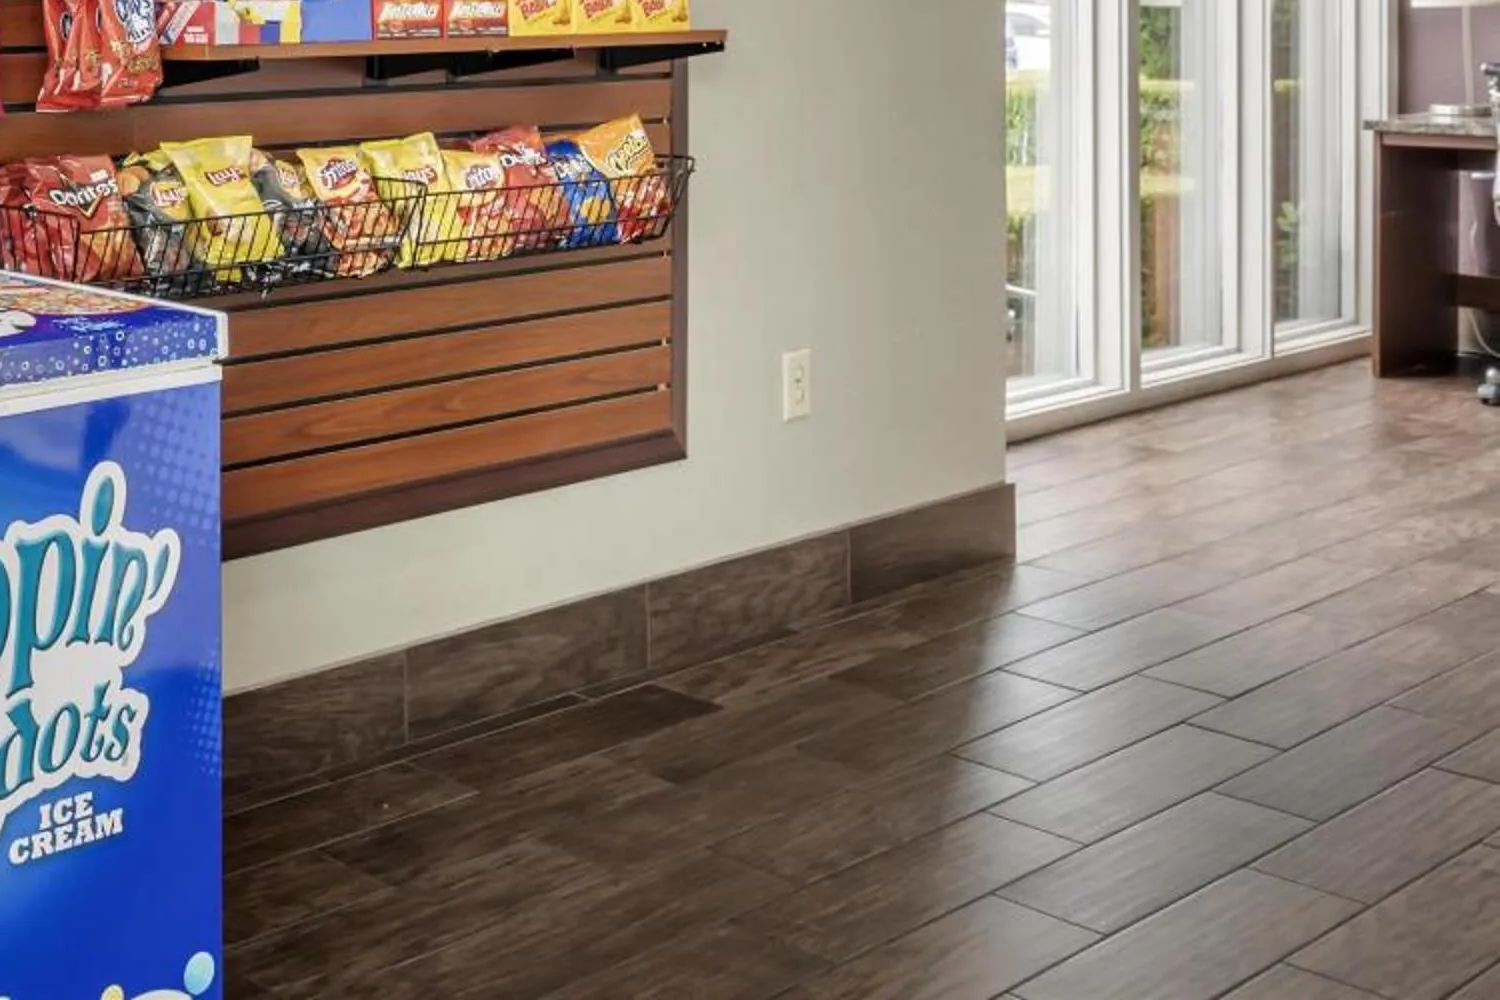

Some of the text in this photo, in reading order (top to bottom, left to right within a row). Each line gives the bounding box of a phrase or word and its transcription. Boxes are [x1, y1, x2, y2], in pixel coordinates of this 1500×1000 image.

[49, 177, 119, 207] Doritos
[40, 793, 94, 831] ICE
[9, 810, 124, 866] CREAM
